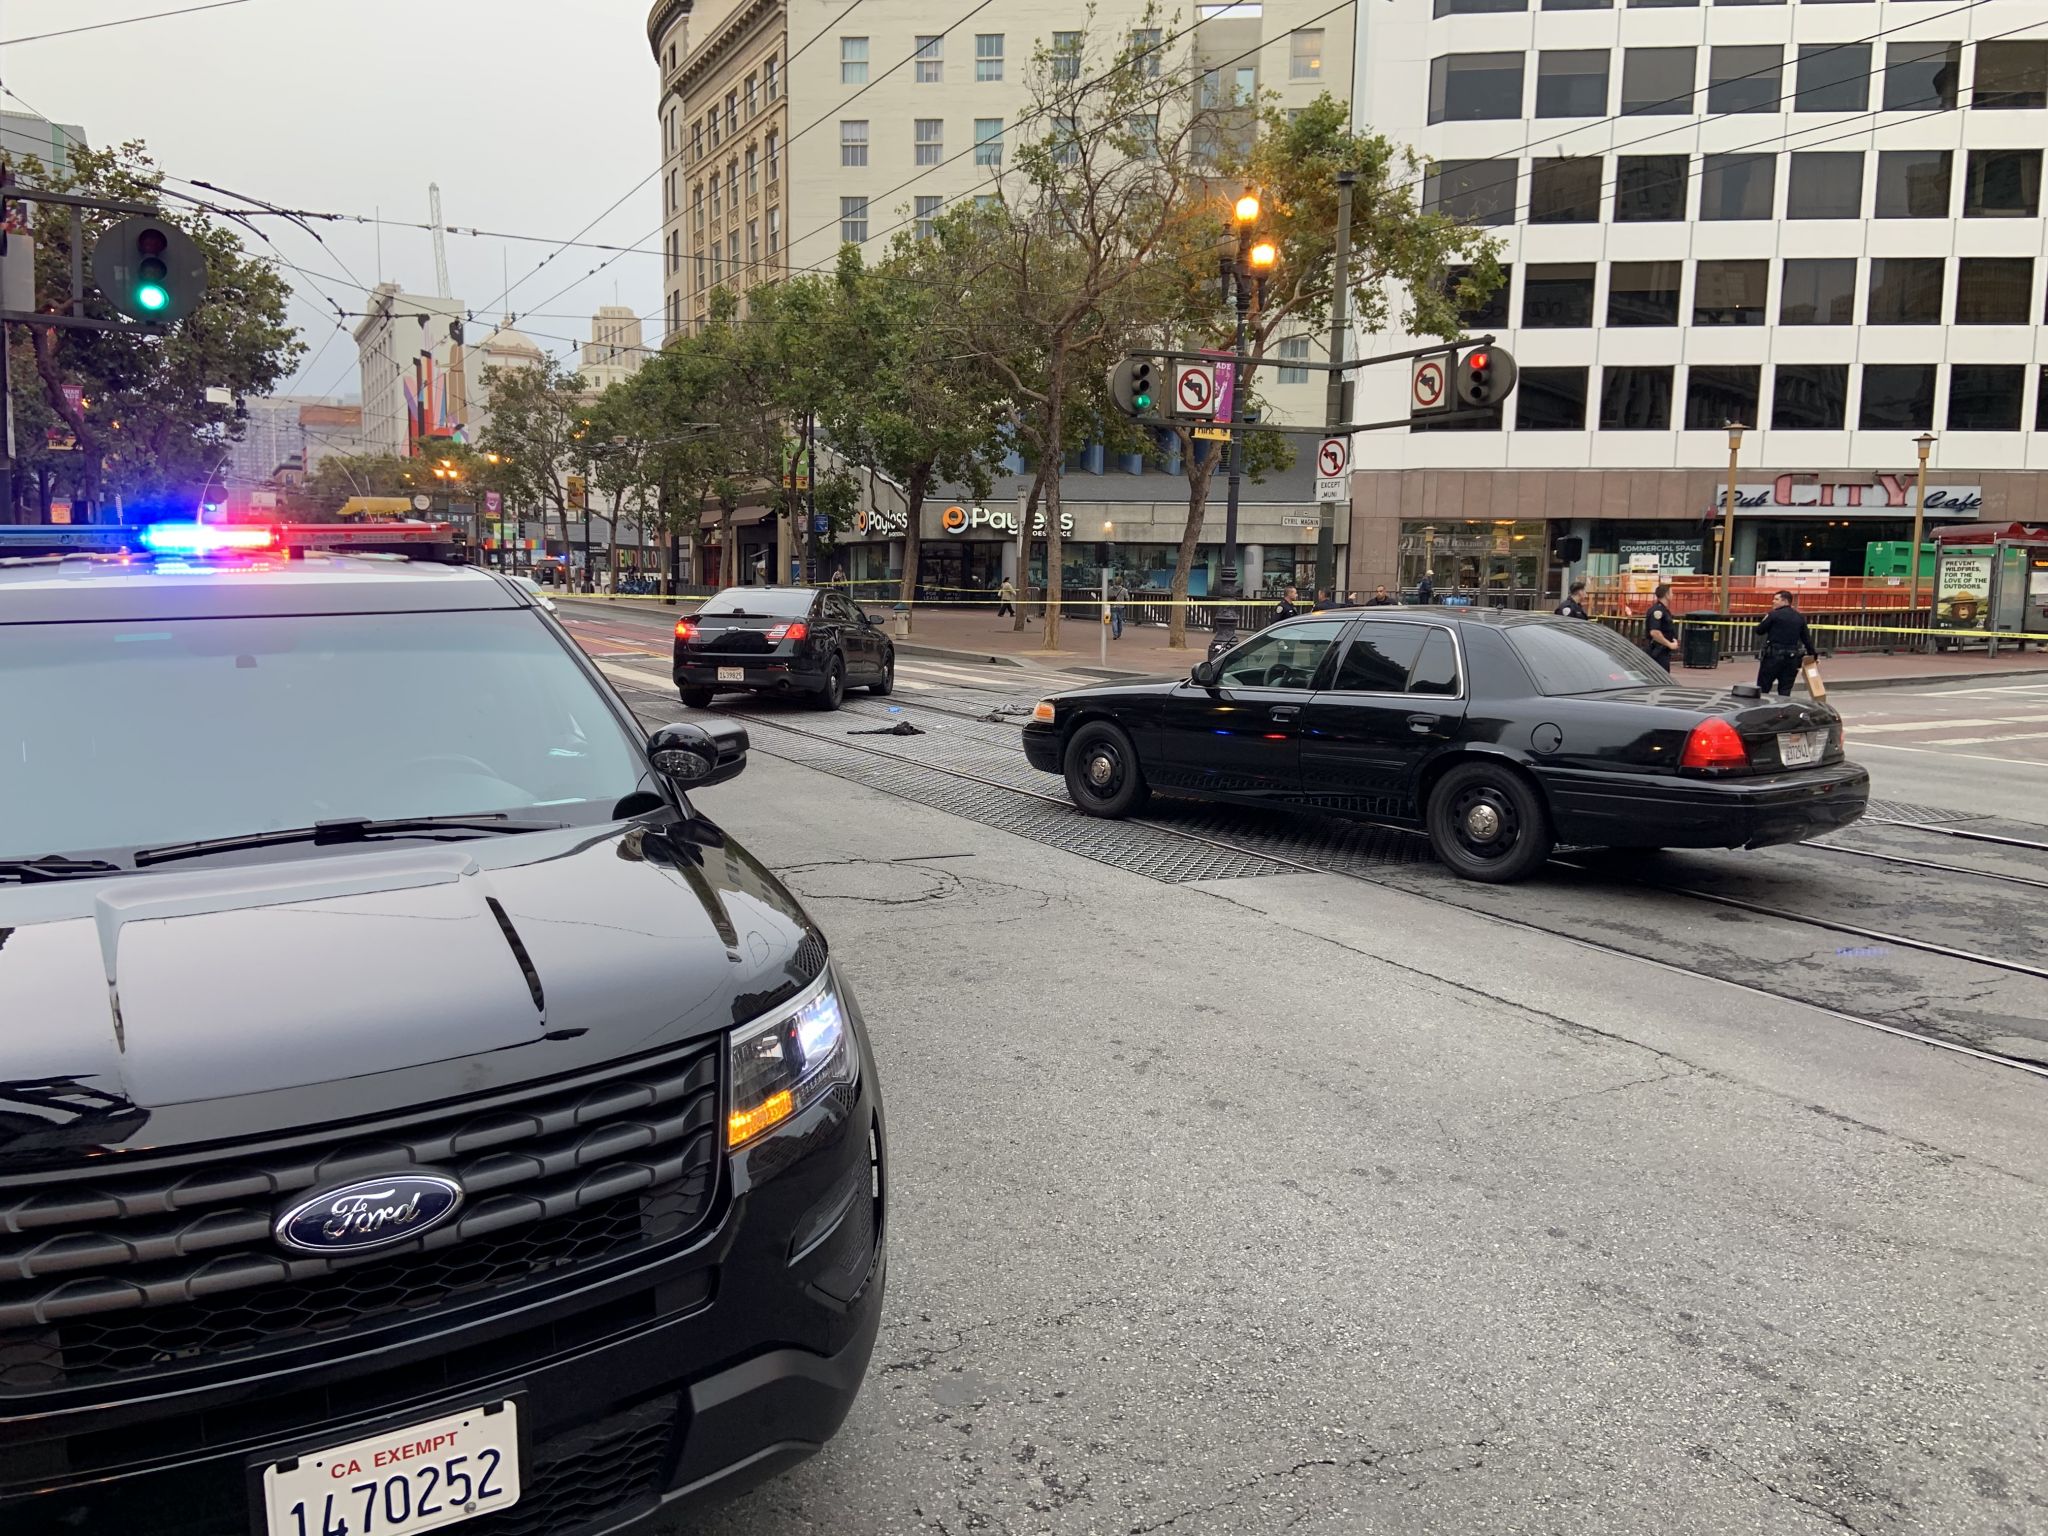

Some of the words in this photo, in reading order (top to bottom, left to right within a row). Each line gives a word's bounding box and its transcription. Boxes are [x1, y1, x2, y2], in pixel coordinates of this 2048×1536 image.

[1320, 481, 1341, 489] EXCEPT
[1323, 490, 1338, 498] MUNI
[1719, 490, 1771, 507] Pub
[1923, 490, 1983, 513] Cafe
[972, 507, 1074, 535] Payes
[1300, 518, 1319, 526] MAGNIN
[322, 1188, 421, 1241] Ford
[330, 1459, 362, 1479] CA
[373, 1431, 459, 1468] EXEMPT
[291, 1447, 503, 1536] 1470252
